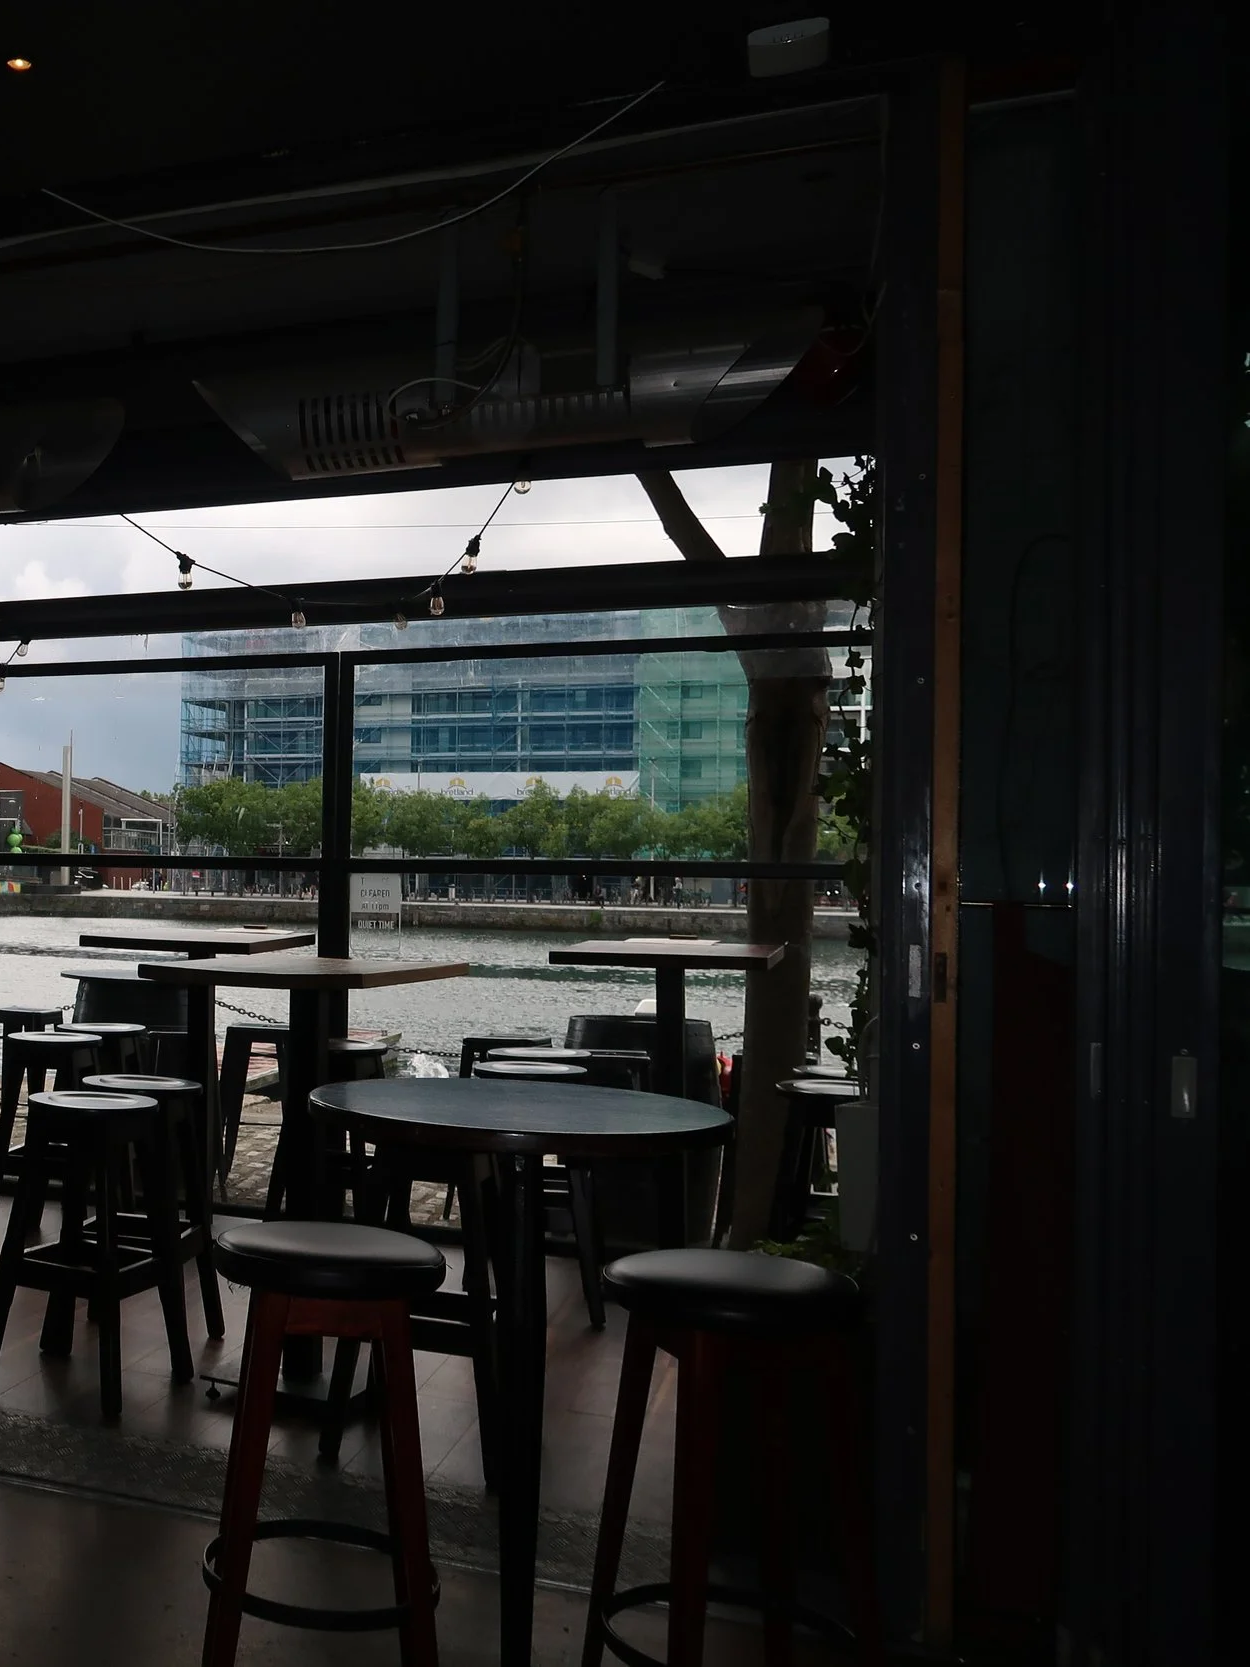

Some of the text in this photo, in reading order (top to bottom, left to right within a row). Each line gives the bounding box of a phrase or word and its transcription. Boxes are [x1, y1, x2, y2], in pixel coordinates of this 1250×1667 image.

[360, 889, 390, 898] CLEARED
[358, 920, 395, 929] QUIET TIME
